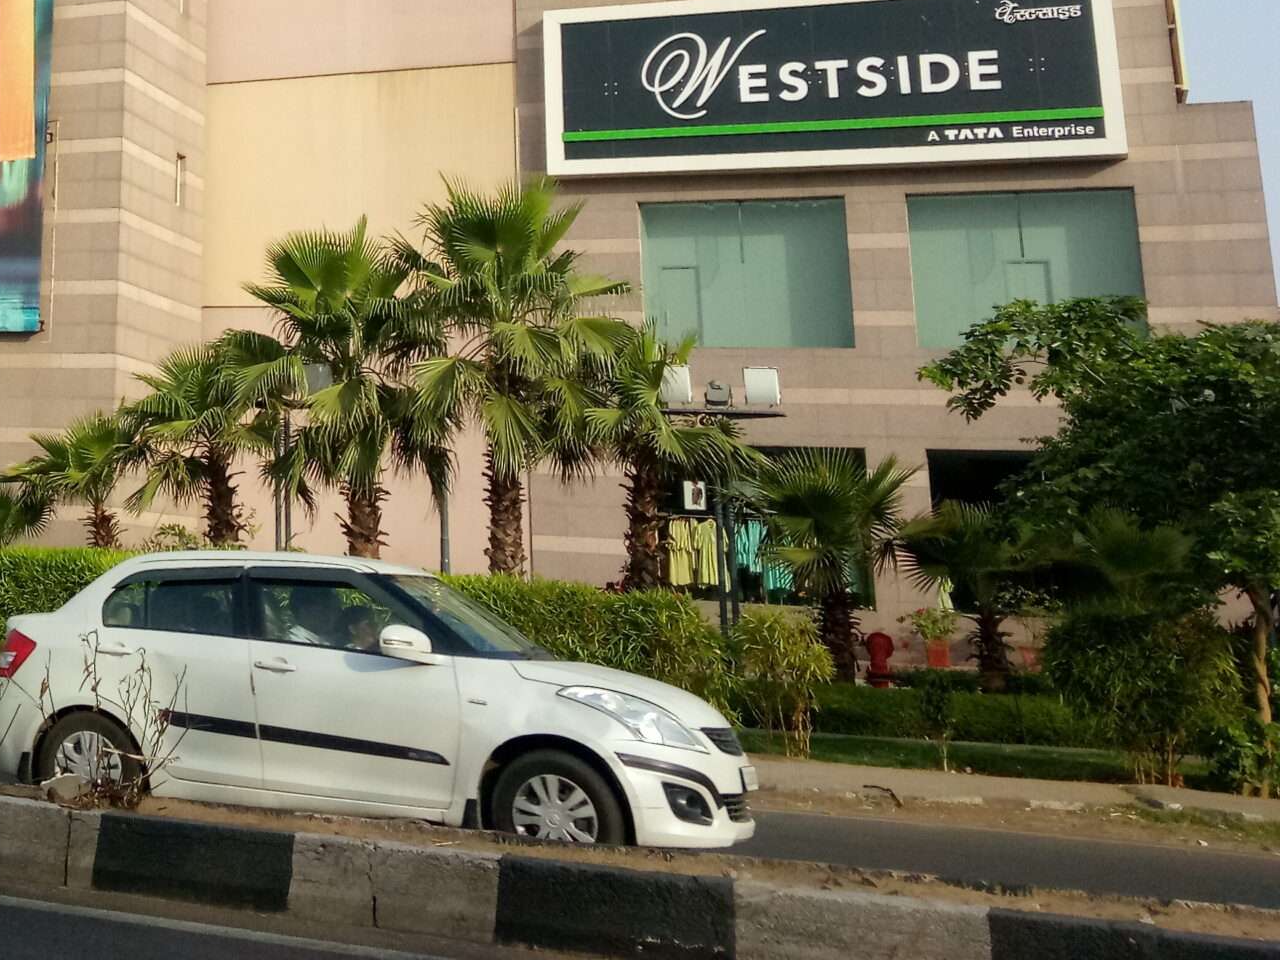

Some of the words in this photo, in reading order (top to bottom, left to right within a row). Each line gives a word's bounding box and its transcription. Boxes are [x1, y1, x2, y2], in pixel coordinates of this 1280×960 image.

[641, 28, 1002, 119] WESTSIDE
[928, 131, 940, 142] A
[945, 127, 1004, 141] TATA
[1012, 123, 1095, 138] Enterprise
